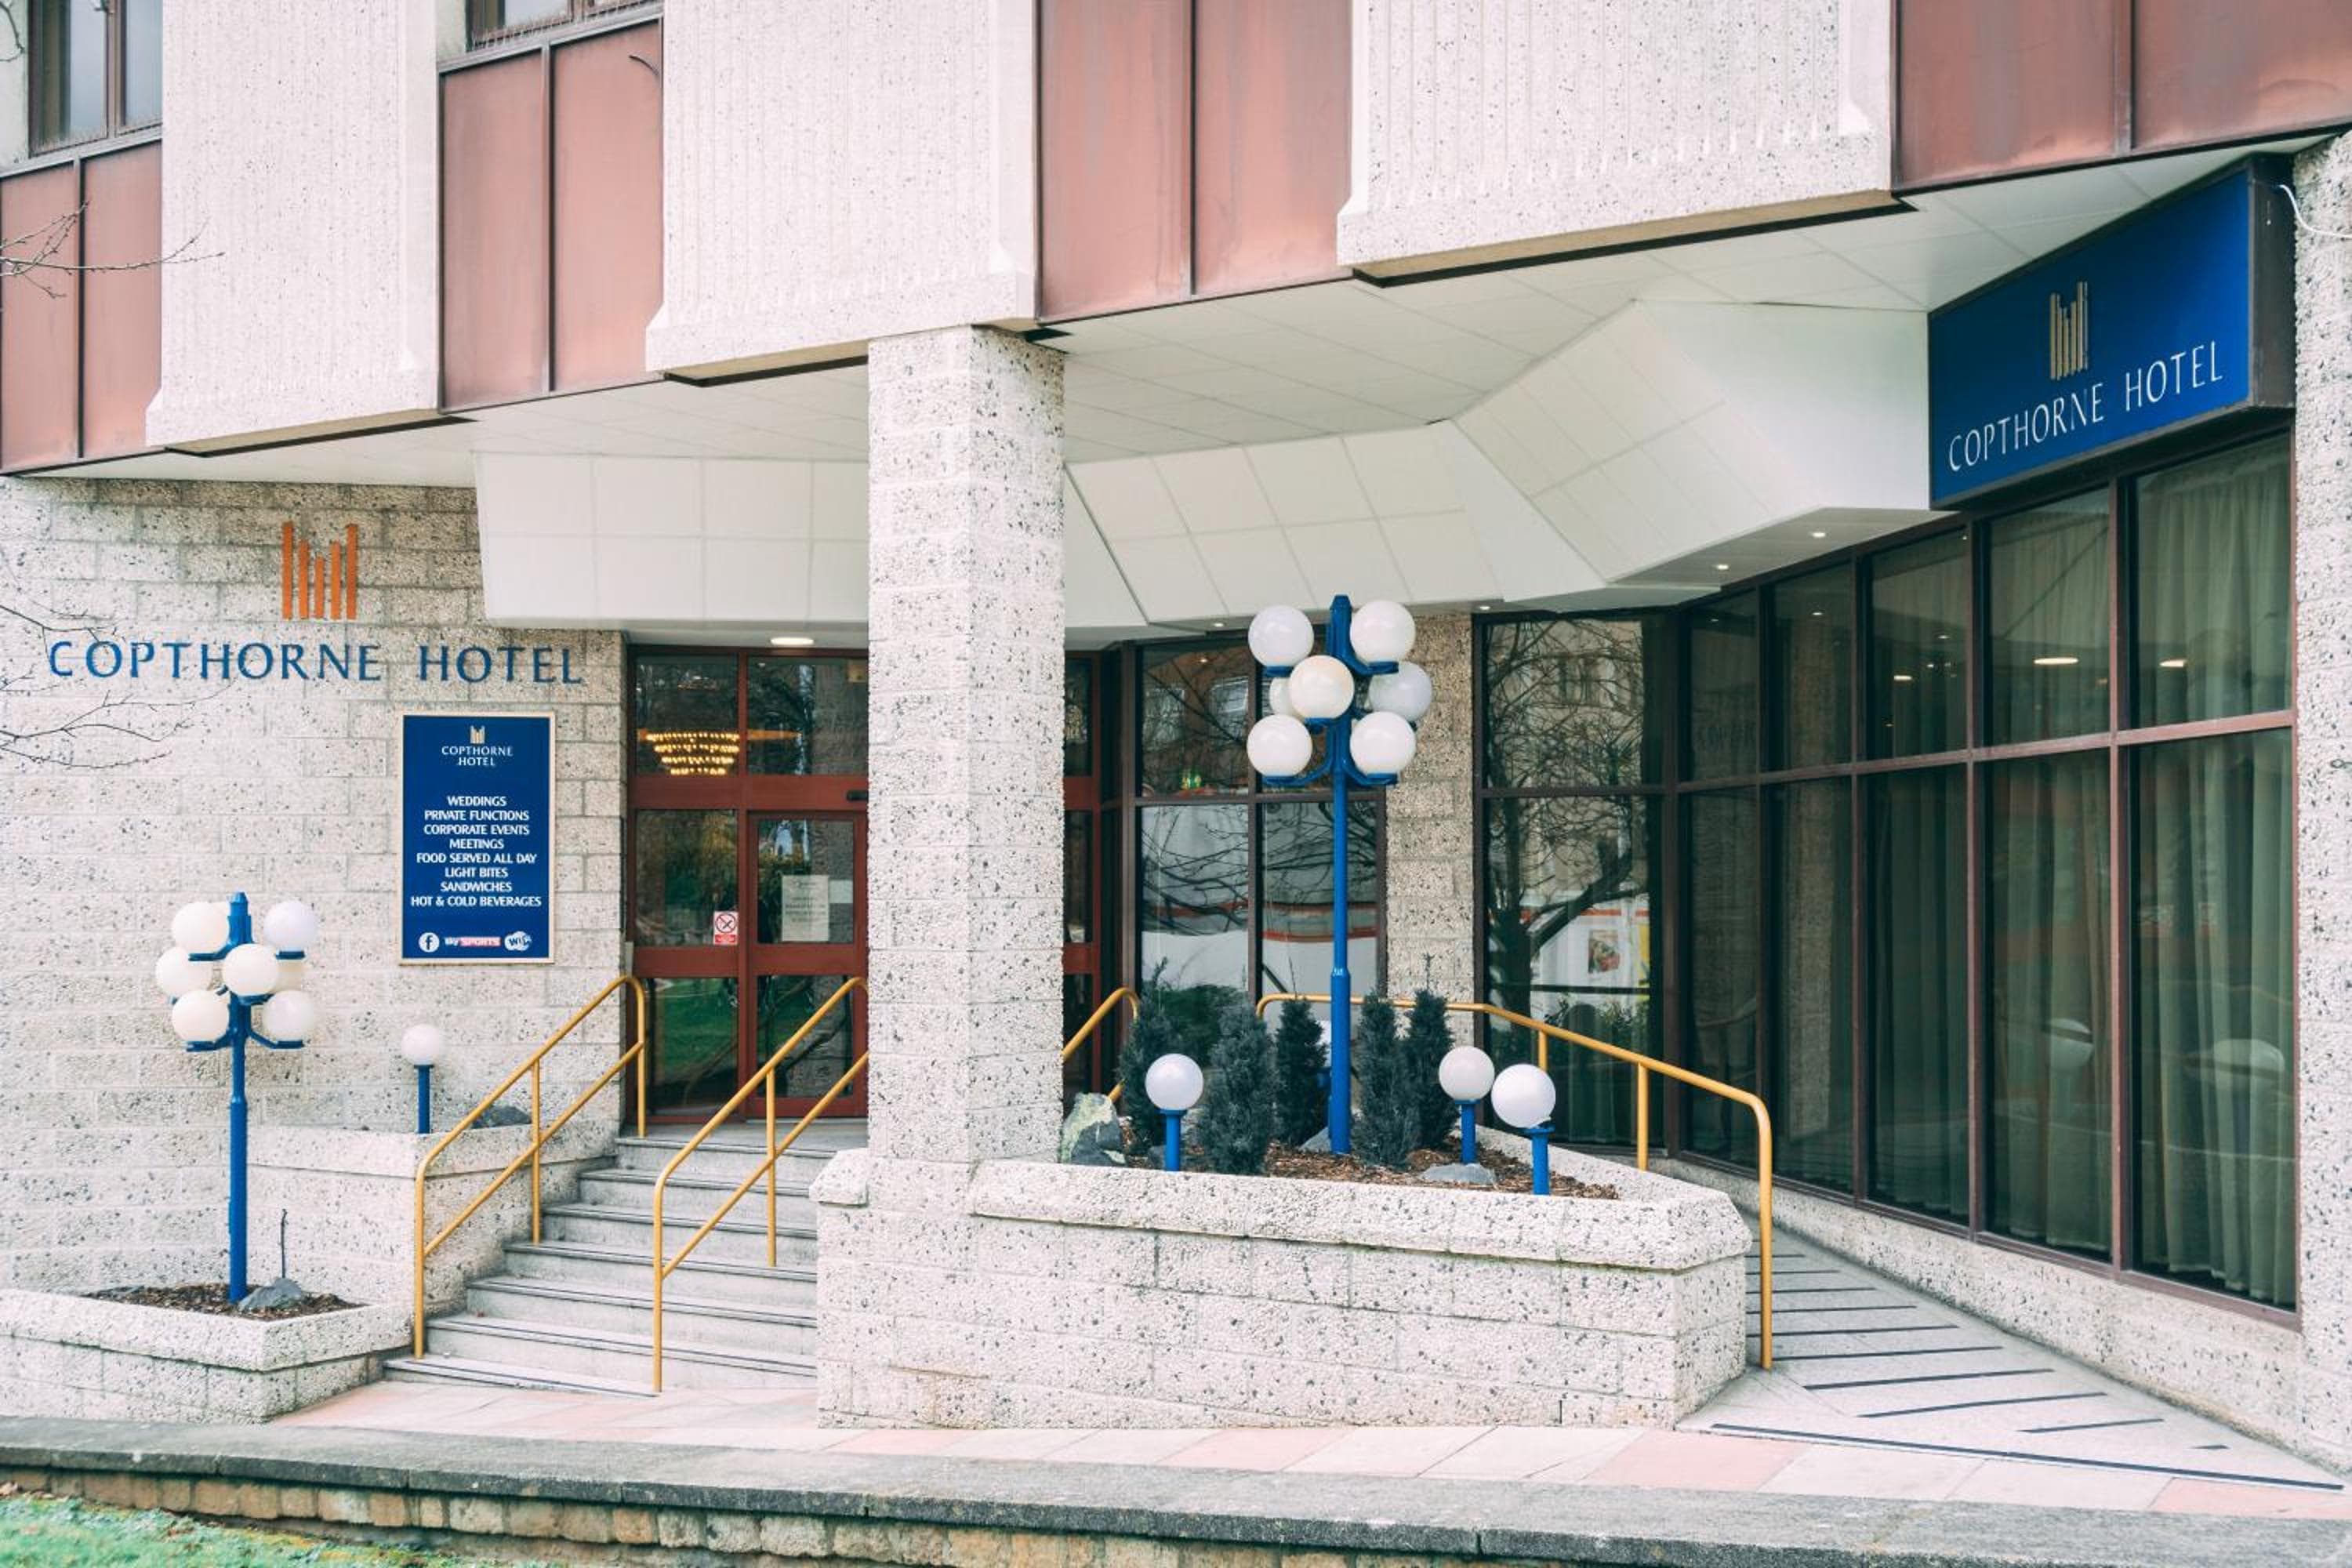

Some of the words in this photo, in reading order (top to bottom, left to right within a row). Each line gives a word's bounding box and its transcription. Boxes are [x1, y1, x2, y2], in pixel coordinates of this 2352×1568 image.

[1949, 382, 2104, 472] COPTHORNE
[2125, 340, 2223, 412] HOTEL
[48, 641, 381, 681] COPTHORNE
[419, 645, 583, 684] HOTEL
[441, 746, 514, 757] COPTHORNE
[459, 757, 495, 767] HOTEL
[447, 796, 507, 807] WEDDINGS
[424, 810, 466, 821] PRIVATE
[470, 810, 529, 821] FUNCTIONS
[423, 824, 487, 835] CORPORATE
[491, 824, 529, 835] EVENTS
[449, 839, 504, 849] MEETINGS
[416, 853, 446, 863] FOOD
[449, 853, 490, 863] SERVED
[494, 853, 513, 864] ALL
[517, 853, 537, 864] DAY
[445, 867, 476, 878] LIGHT
[480, 867, 508, 878] BITES
[441, 881, 512, 892] SANDWICHES
[411, 896, 432, 906] HOT
[435, 896, 445, 906] &
[448, 896, 477, 906] COLD
[480, 896, 541, 906] BEVERAGES
